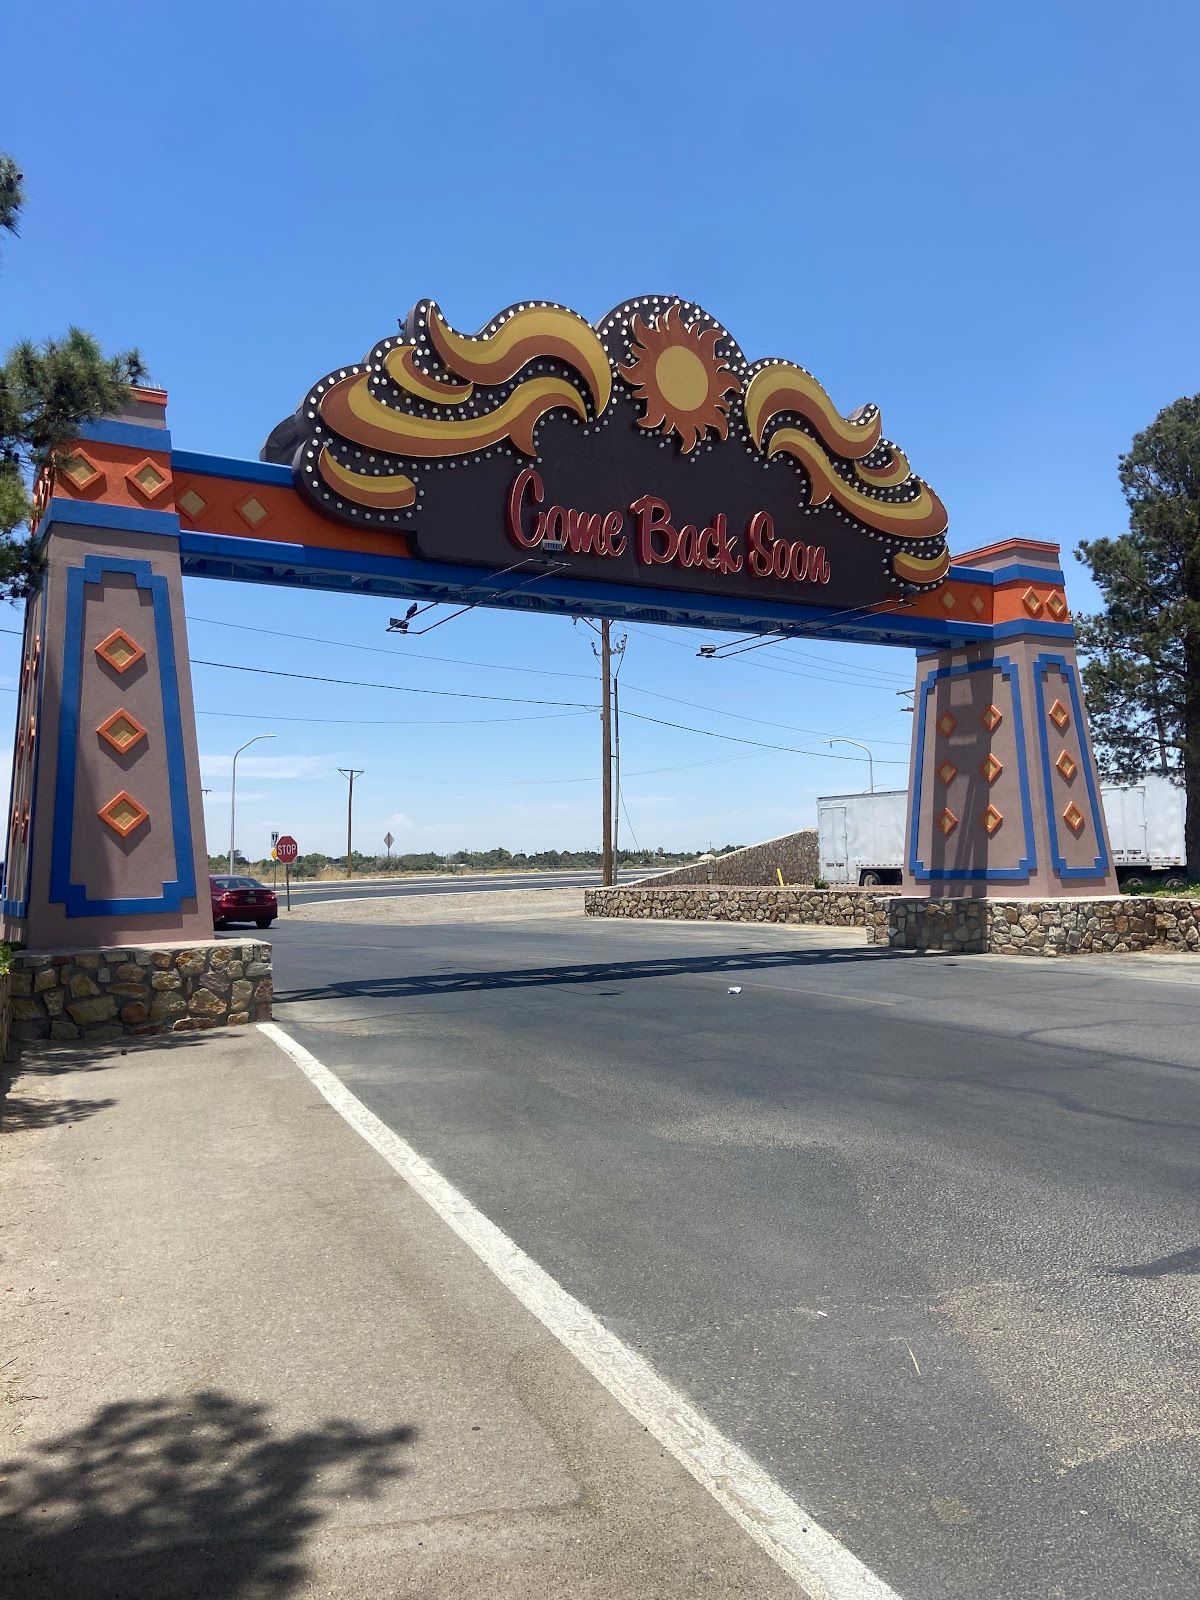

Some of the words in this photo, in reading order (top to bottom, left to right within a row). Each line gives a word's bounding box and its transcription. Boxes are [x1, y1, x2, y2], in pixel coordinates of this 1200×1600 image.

[509, 468, 627, 556] Come
[628, 494, 743, 574] Back
[747, 510, 831, 584] Soon
[277, 844, 296, 855] STOP
